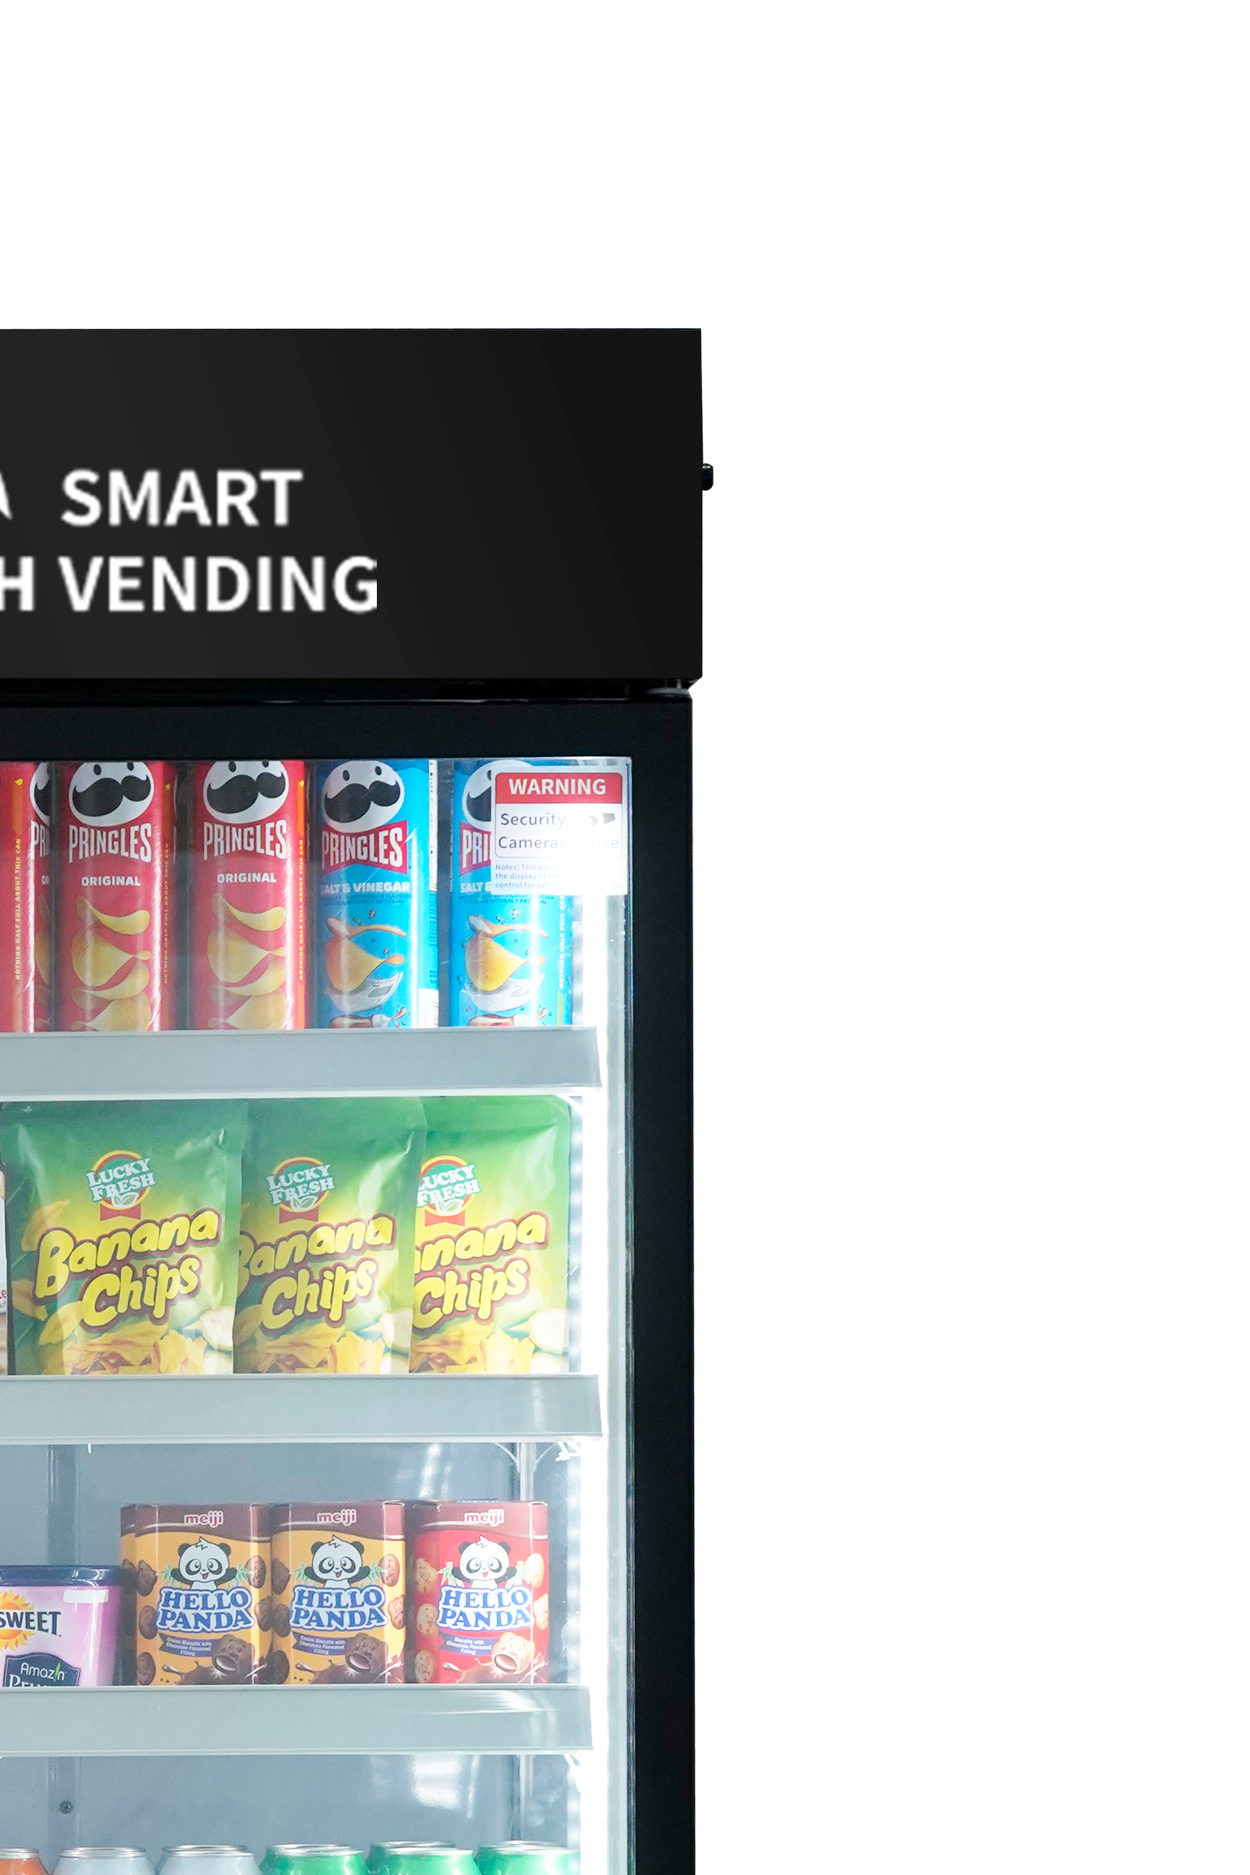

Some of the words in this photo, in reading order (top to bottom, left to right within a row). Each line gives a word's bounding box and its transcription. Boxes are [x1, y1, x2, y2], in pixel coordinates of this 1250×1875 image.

[60, 469, 304, 526] SMART
[58, 554, 378, 613] VENDING
[508, 778, 607, 795] WARNING
[500, 812, 566, 828] Security
[68, 822, 152, 864] PRINGLES
[203, 819, 287, 861] PRINGLES
[321, 826, 404, 869] PRINGLES
[498, 836, 567, 849] Cameras
[81, 876, 141, 887] ORIGINAL
[216, 872, 277, 884] ORIGINAL
[353, 881, 411, 893] VINEGAR
[495, 881, 523, 889] control
[509, 873, 536, 881] display
[86, 1157, 151, 1187] LUCKY
[265, 1163, 332, 1190] LUCKY
[90, 1172, 156, 1202] FRESH
[270, 1176, 336, 1206] FRESH
[417, 1177, 481, 1208] FRESH
[415, 1213, 547, 1274] nana
[35, 1210, 220, 1299] Banana
[82, 1256, 201, 1327] Chips
[261, 1256, 377, 1330] Chips
[413, 1256, 529, 1329] Chips
[185, 1511, 224, 1528] meiji
[318, 1509, 356, 1526] meiji
[465, 1509, 504, 1526] meiji
[160, 1588, 250, 1610] HELLO
[294, 1588, 384, 1609] HELLO
[442, 1588, 529, 1609] HELLO
[158, 1610, 252, 1630] PANDA
[291, 1608, 386, 1629] PANDA
[439, 1608, 531, 1629] PANDA
